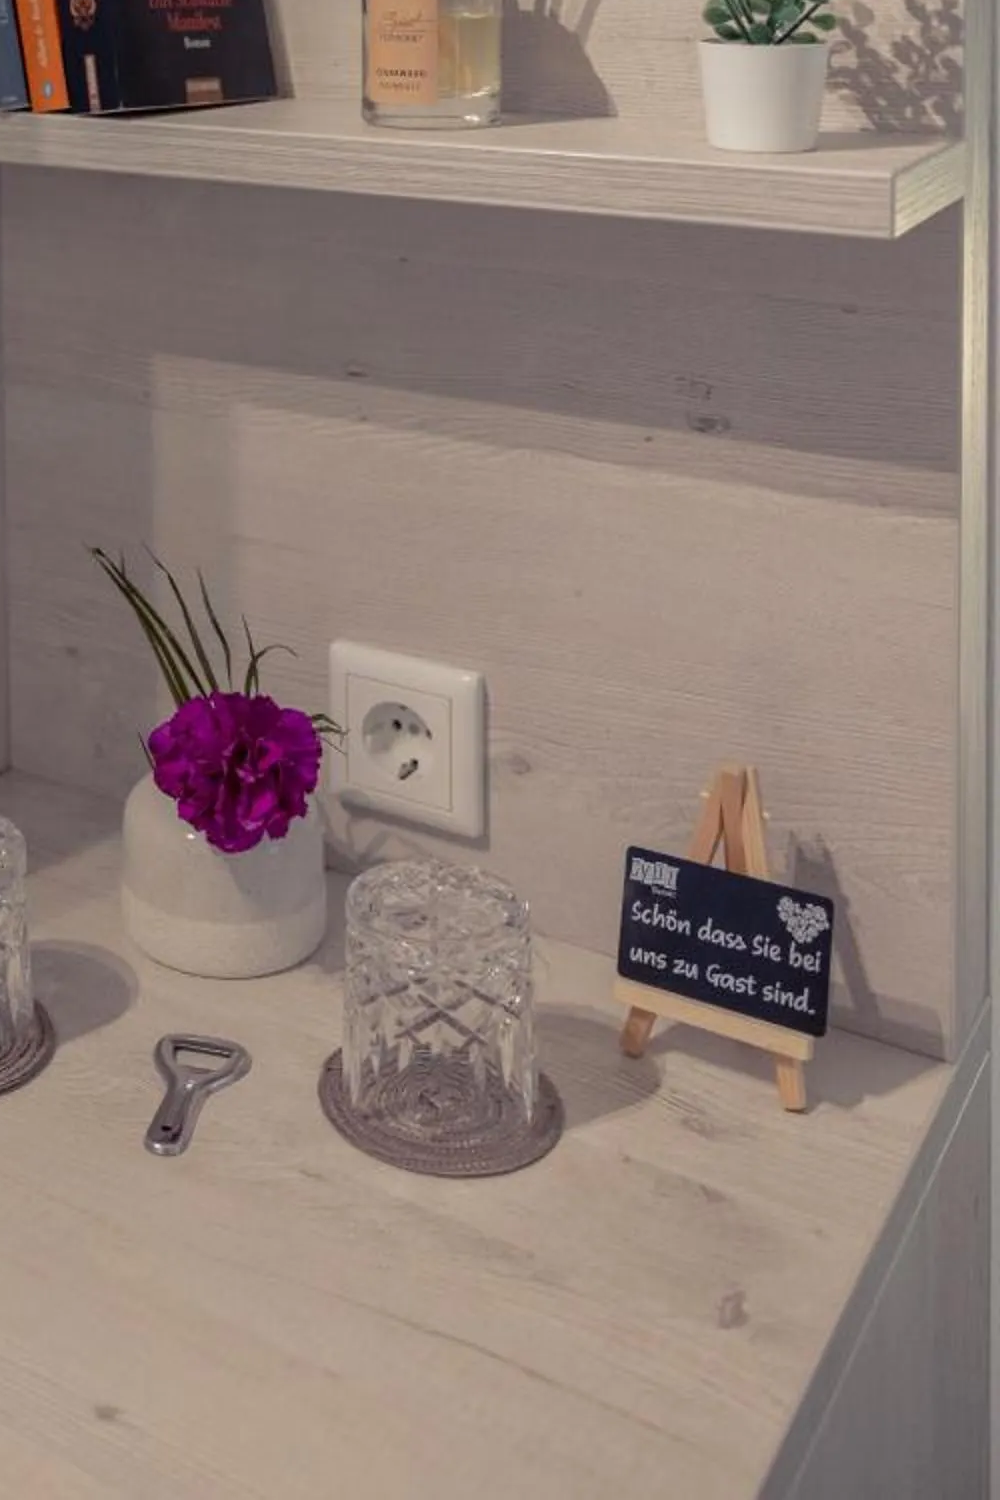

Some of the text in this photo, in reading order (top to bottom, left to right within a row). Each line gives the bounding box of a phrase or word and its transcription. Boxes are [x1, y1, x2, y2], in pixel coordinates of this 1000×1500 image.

[631, 899, 823, 974] Schön dass Sie bei
[629, 946, 816, 1016] uns zu Gast sind.
